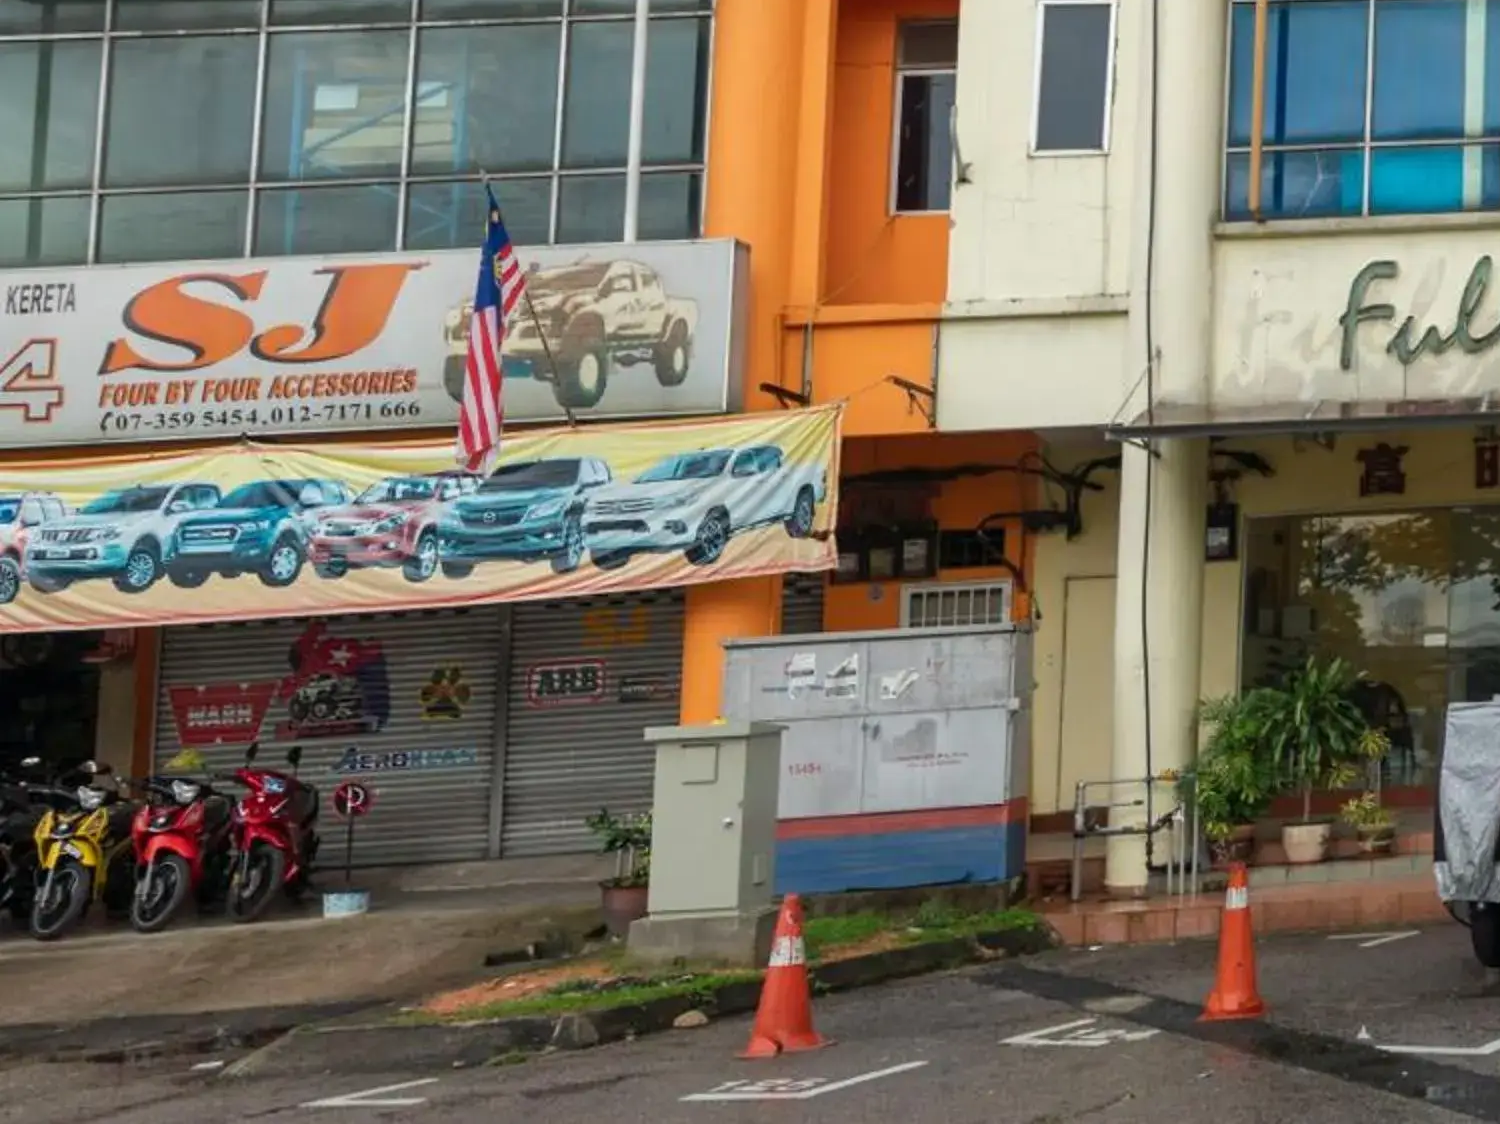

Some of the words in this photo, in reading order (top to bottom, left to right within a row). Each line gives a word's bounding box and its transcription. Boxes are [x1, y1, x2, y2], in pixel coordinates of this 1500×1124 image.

[5, 283, 76, 315] KERETA
[98, 260, 430, 375] SJ
[98, 381, 157, 408] FOUR
[164, 379, 196, 404] BY
[200, 377, 261, 402] FOUR
[267, 368, 418, 400] ACCESSORIES
[115, 408, 195, 431] 07-359
[380, 399, 421, 418] 666
